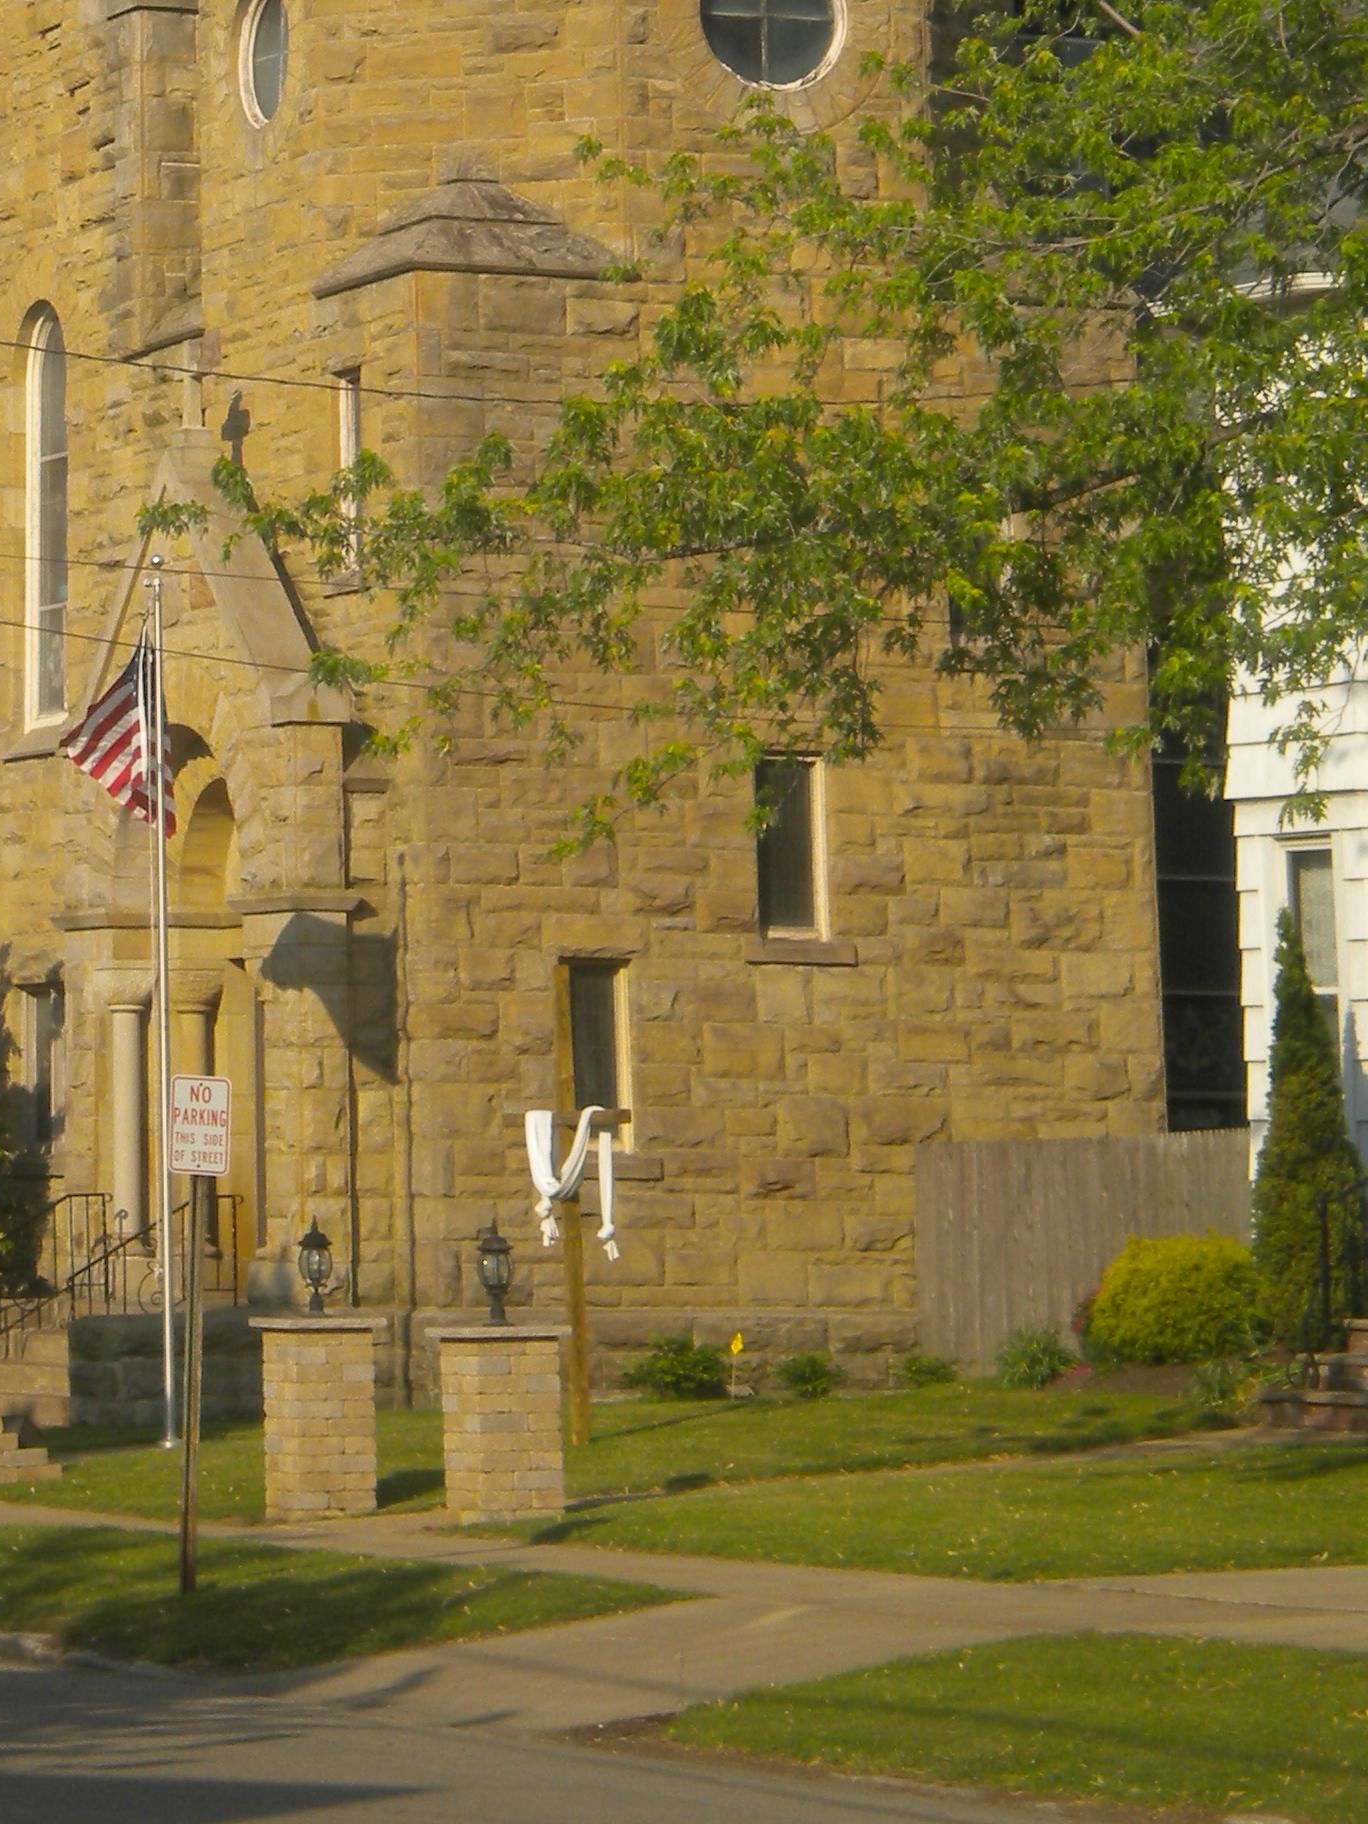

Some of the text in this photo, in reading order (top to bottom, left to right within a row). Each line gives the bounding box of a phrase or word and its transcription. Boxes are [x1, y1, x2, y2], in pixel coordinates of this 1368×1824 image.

[190, 1086, 211, 1103] NO
[173, 1108, 227, 1127] PARKING
[175, 1131, 224, 1147] THIS SIDE
[174, 1149, 224, 1165] OF STREET
